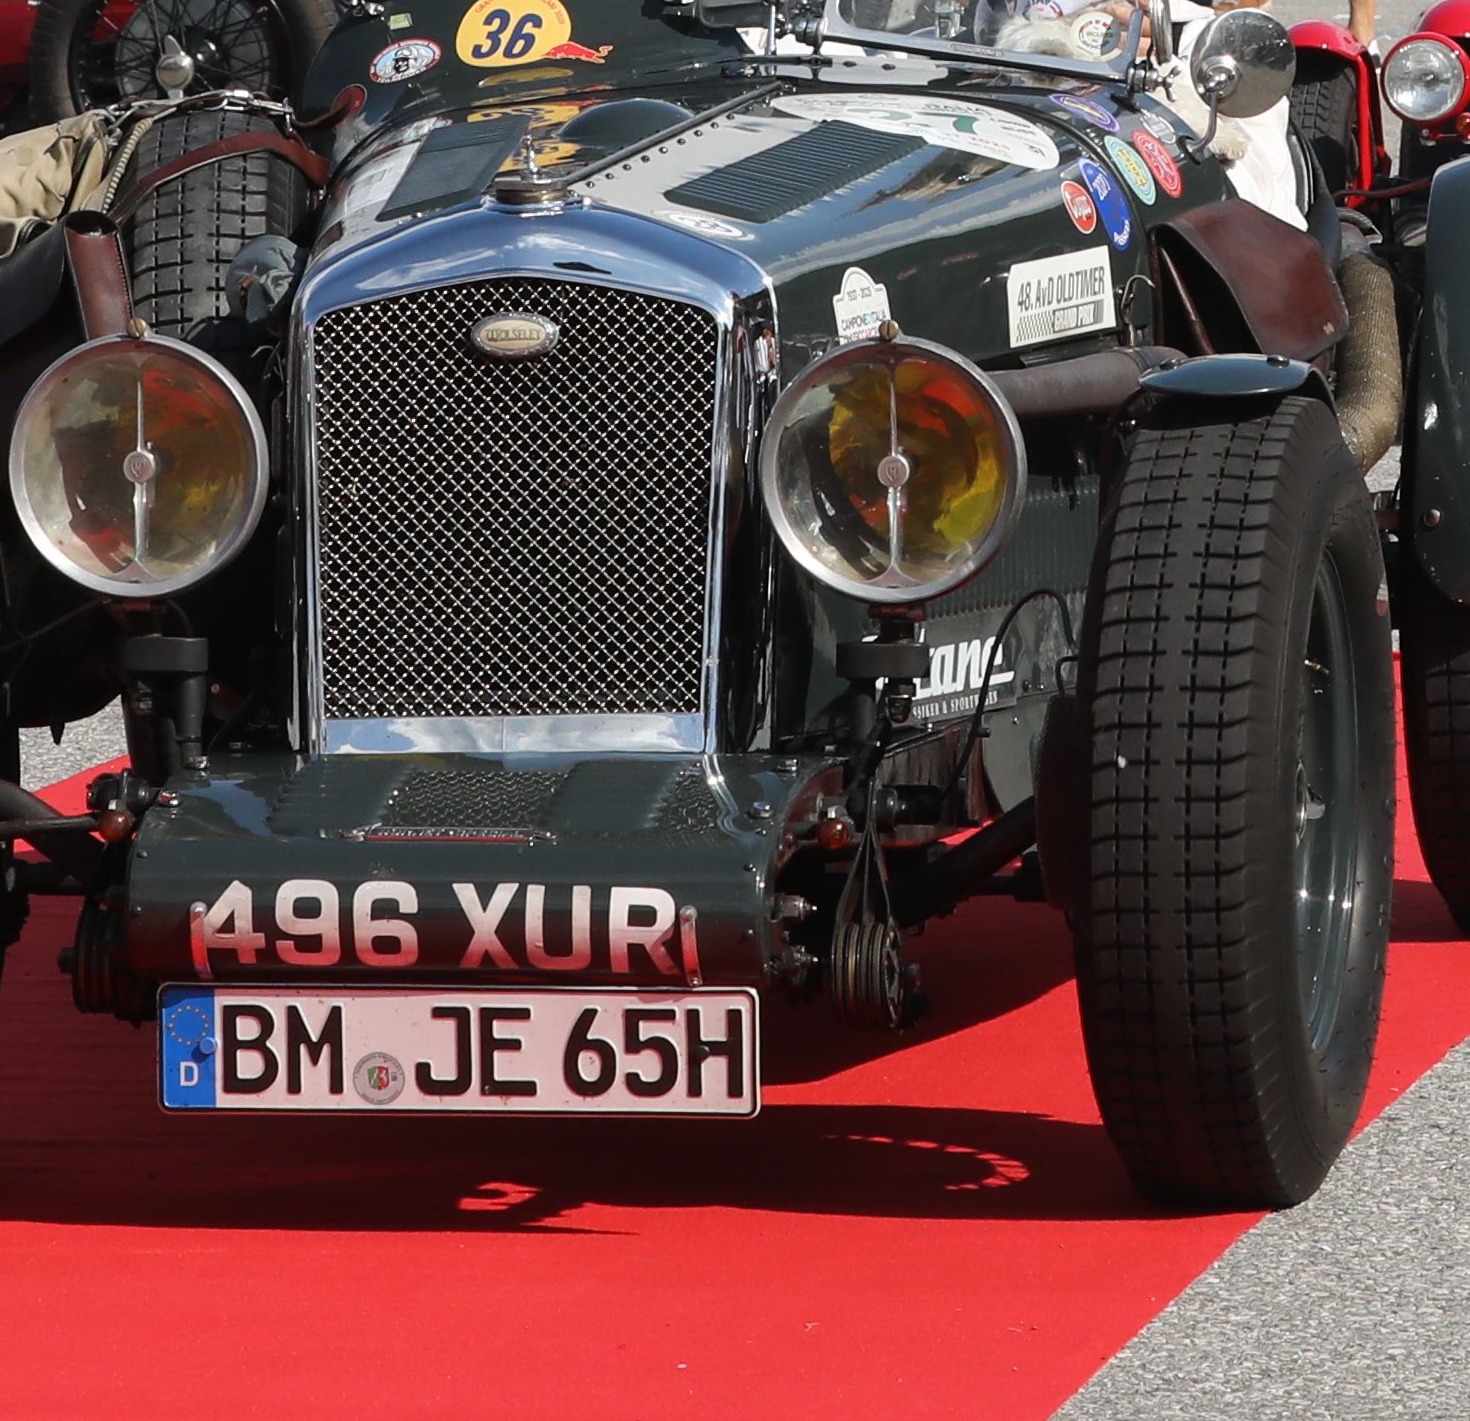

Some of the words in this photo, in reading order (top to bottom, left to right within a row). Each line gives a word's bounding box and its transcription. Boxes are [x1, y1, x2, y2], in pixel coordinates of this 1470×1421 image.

[470, 7, 544, 60] 36
[1056, 266, 1105, 304] OLDTIMER
[201, 879, 420, 968] 496
[451, 882, 683, 975] XUR
[179, 1061, 200, 1088] D
[221, 1003, 345, 1097] BM
[415, 1005, 538, 1098] JE
[563, 1005, 745, 1099] 65H
